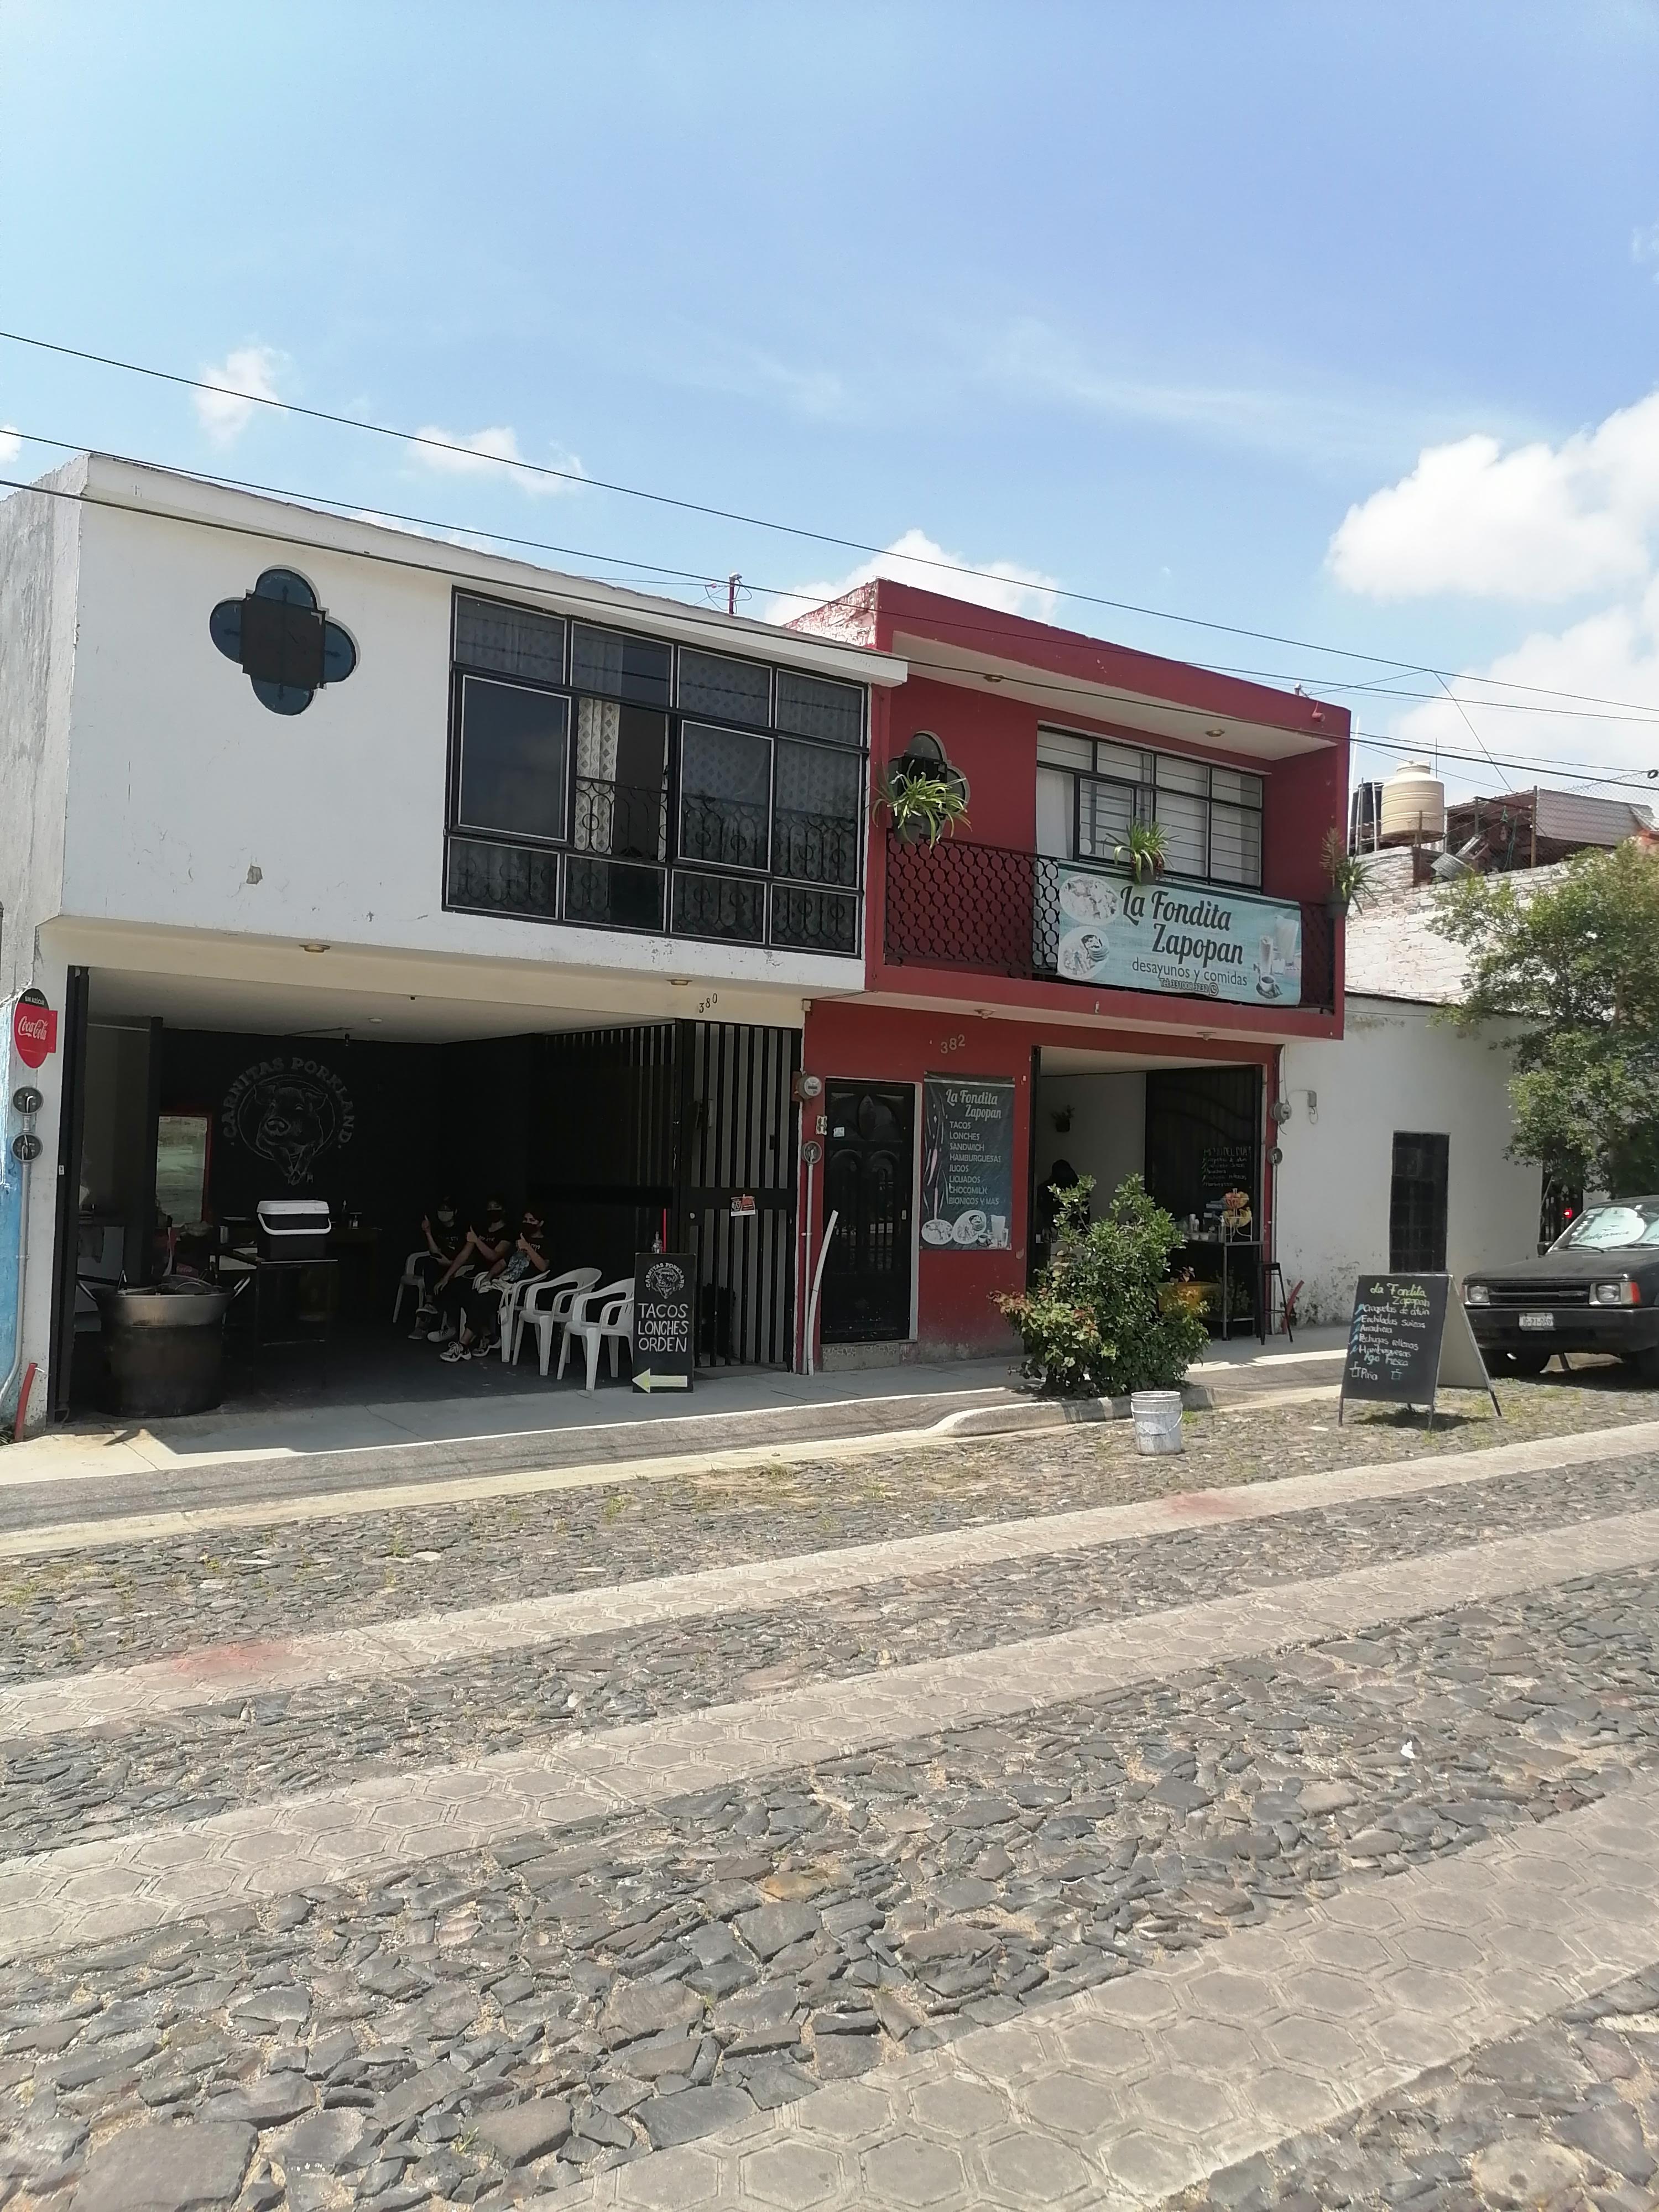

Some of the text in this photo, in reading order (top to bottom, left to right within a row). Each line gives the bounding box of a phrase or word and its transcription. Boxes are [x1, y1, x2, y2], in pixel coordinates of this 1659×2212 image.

[1120, 886, 1232, 931] La Fondita
[1152, 923, 1243, 968] Zapopan
[1132, 957, 1248, 986] desayunos y comidas
[699, 993, 718, 1013] 380
[941, 1034, 965, 1053] 382
[222, 1057, 354, 1143] CARNITAS PORKLAND
[946, 1089, 998, 1107] La Fondita
[965, 1104, 1001, 1121] Zapopan
[949, 1121, 972, 1129] TACOS
[949, 1131, 980, 1141] LONCHES
[950, 1142, 984, 1151] SANDWICH
[950, 1153, 1001, 1163] HAMBURGUESAS
[949, 1164, 969, 1173] JUGOS
[949, 1175, 980, 1183] LICUADOS
[949, 1186, 988, 1194] CHOCOMILK
[980, 1197, 985, 1206] Y
[645, 1262, 664, 1288] CARNITAS
[1386, 1282, 1427, 1297] Fondita
[1363, 1302, 1397, 1314] Croquetas
[1399, 1306, 1408, 1314] de
[1392, 1296, 1430, 1309] Zapopan
[638, 1303, 689, 1318] TACOS
[638, 1320, 690, 1335] LONCHES
[638, 1336, 687, 1352] ORDEN
